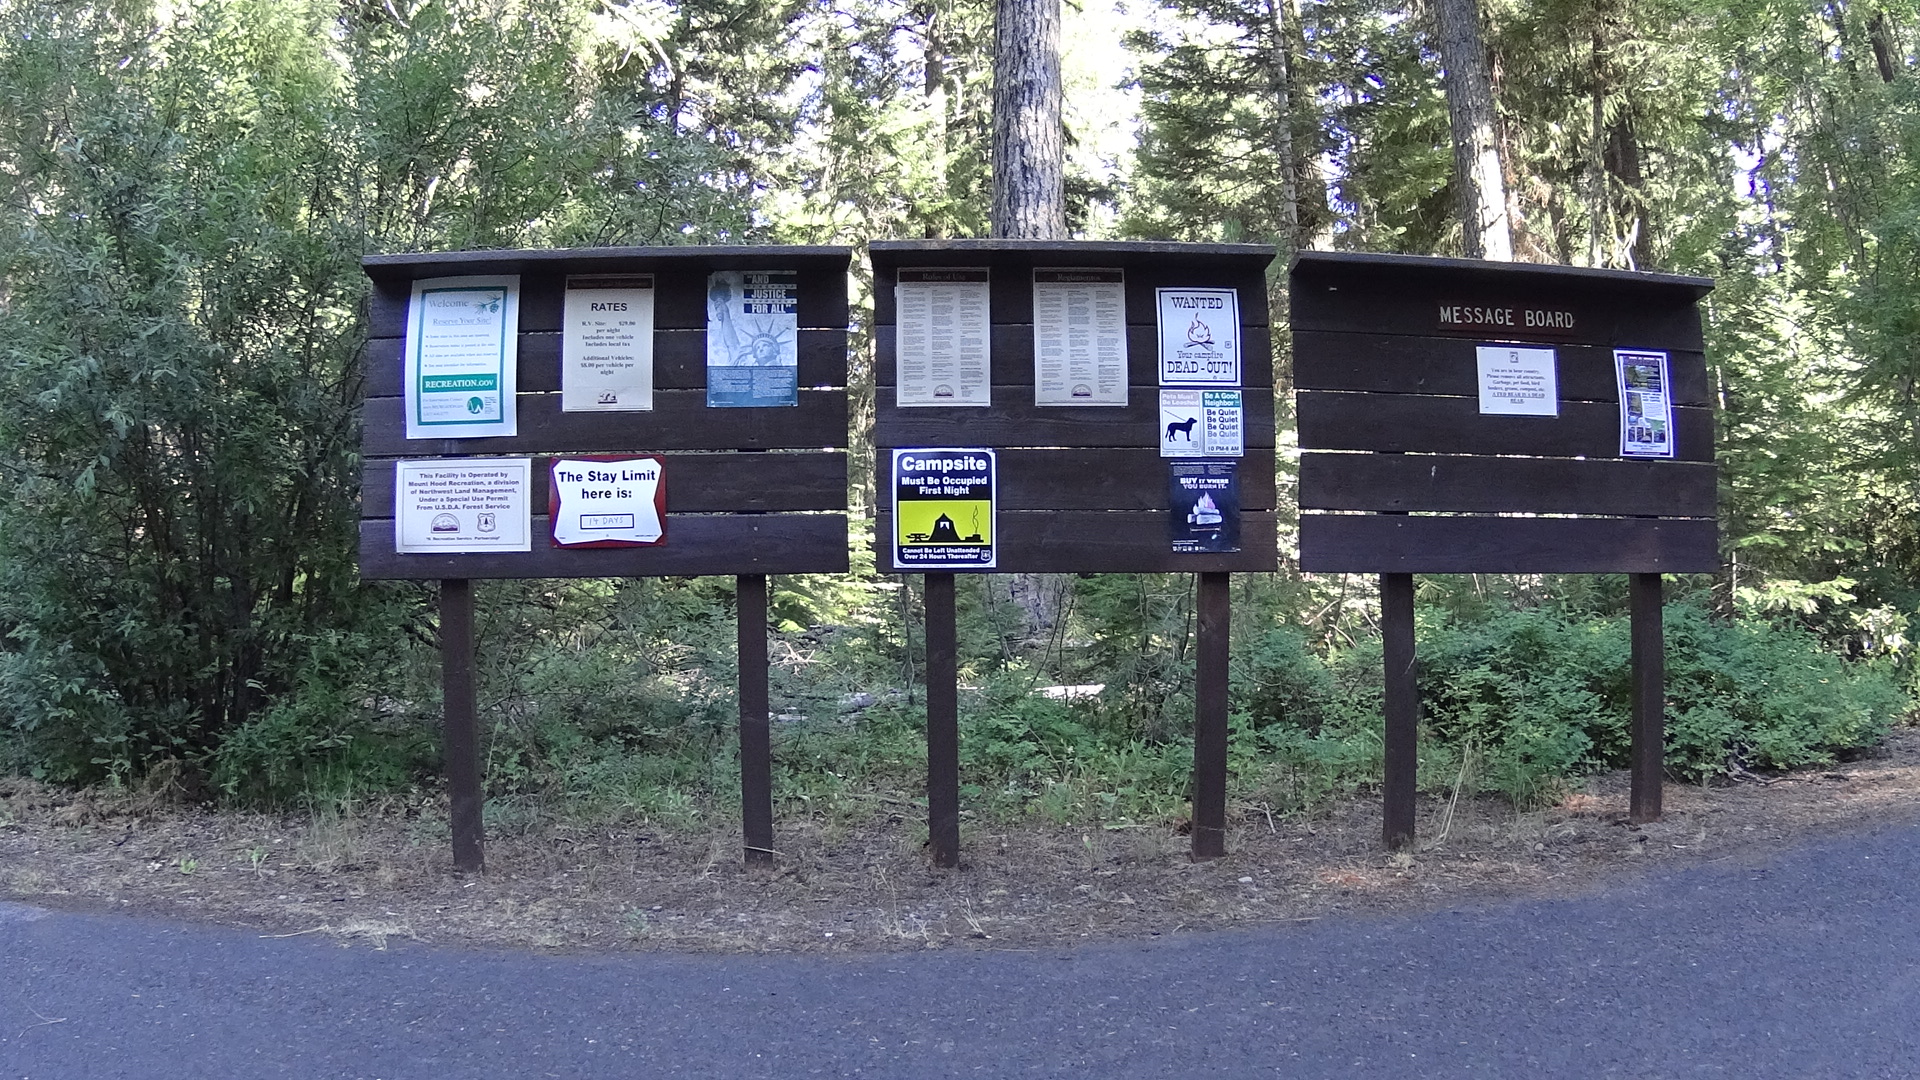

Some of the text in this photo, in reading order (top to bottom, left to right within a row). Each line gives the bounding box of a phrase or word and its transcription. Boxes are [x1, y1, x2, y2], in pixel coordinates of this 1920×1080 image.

[751, 290, 786, 298] JUSTICE
[428, 300, 470, 308] Welcome
[590, 302, 628, 311] RATES
[1170, 297, 1224, 309] WANTED
[752, 304, 768, 313] FOR
[1440, 306, 1574, 328] MESSAGE BOARD
[1176, 350, 1223, 361] Your campfire
[902, 456, 987, 474] Campsite
[558, 470, 656, 484] The Stay Limit
[902, 476, 987, 486] Must Be Occupied
[582, 487, 632, 499] here is:
[944, 486, 969, 496] Night
